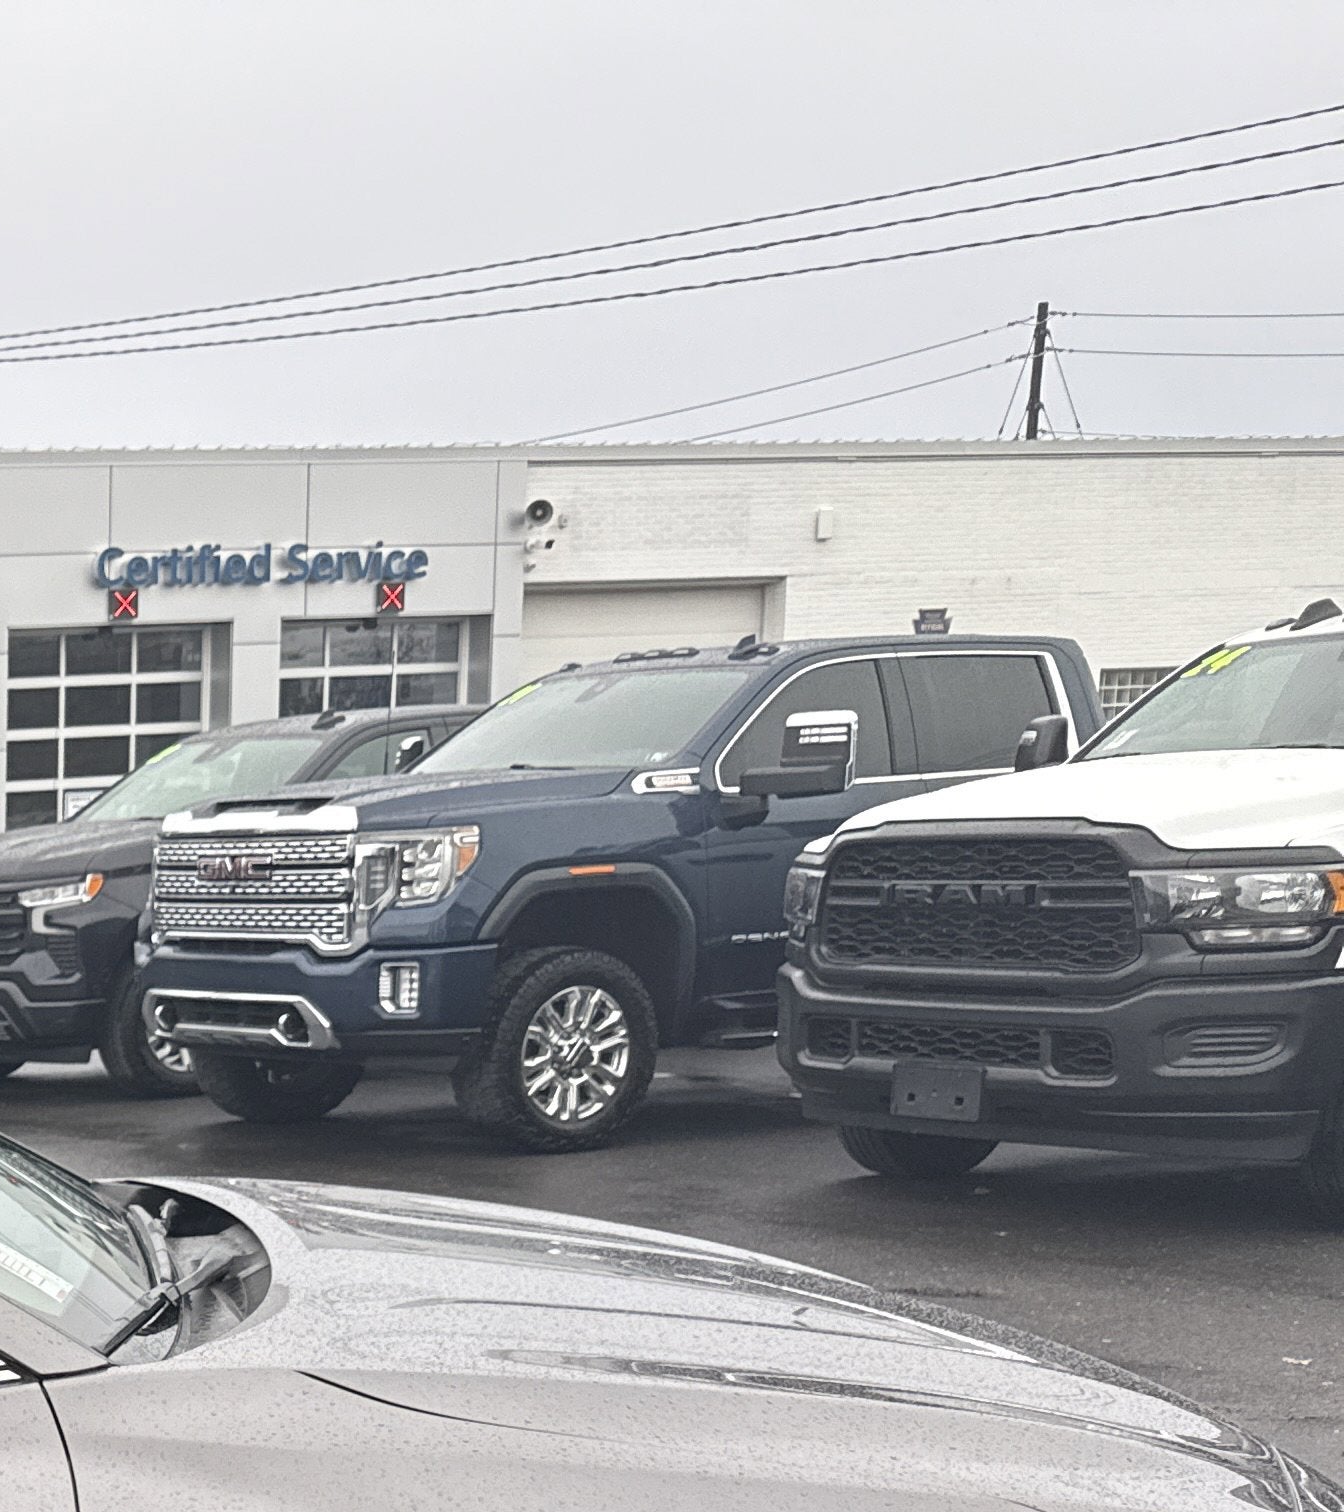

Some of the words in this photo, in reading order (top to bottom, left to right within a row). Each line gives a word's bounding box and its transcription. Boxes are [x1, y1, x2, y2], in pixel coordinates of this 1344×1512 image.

[97, 543, 272, 587] Certified
[285, 541, 428, 583] Service
[197, 856, 272, 880] GMC
[892, 882, 1027, 906] RAM
